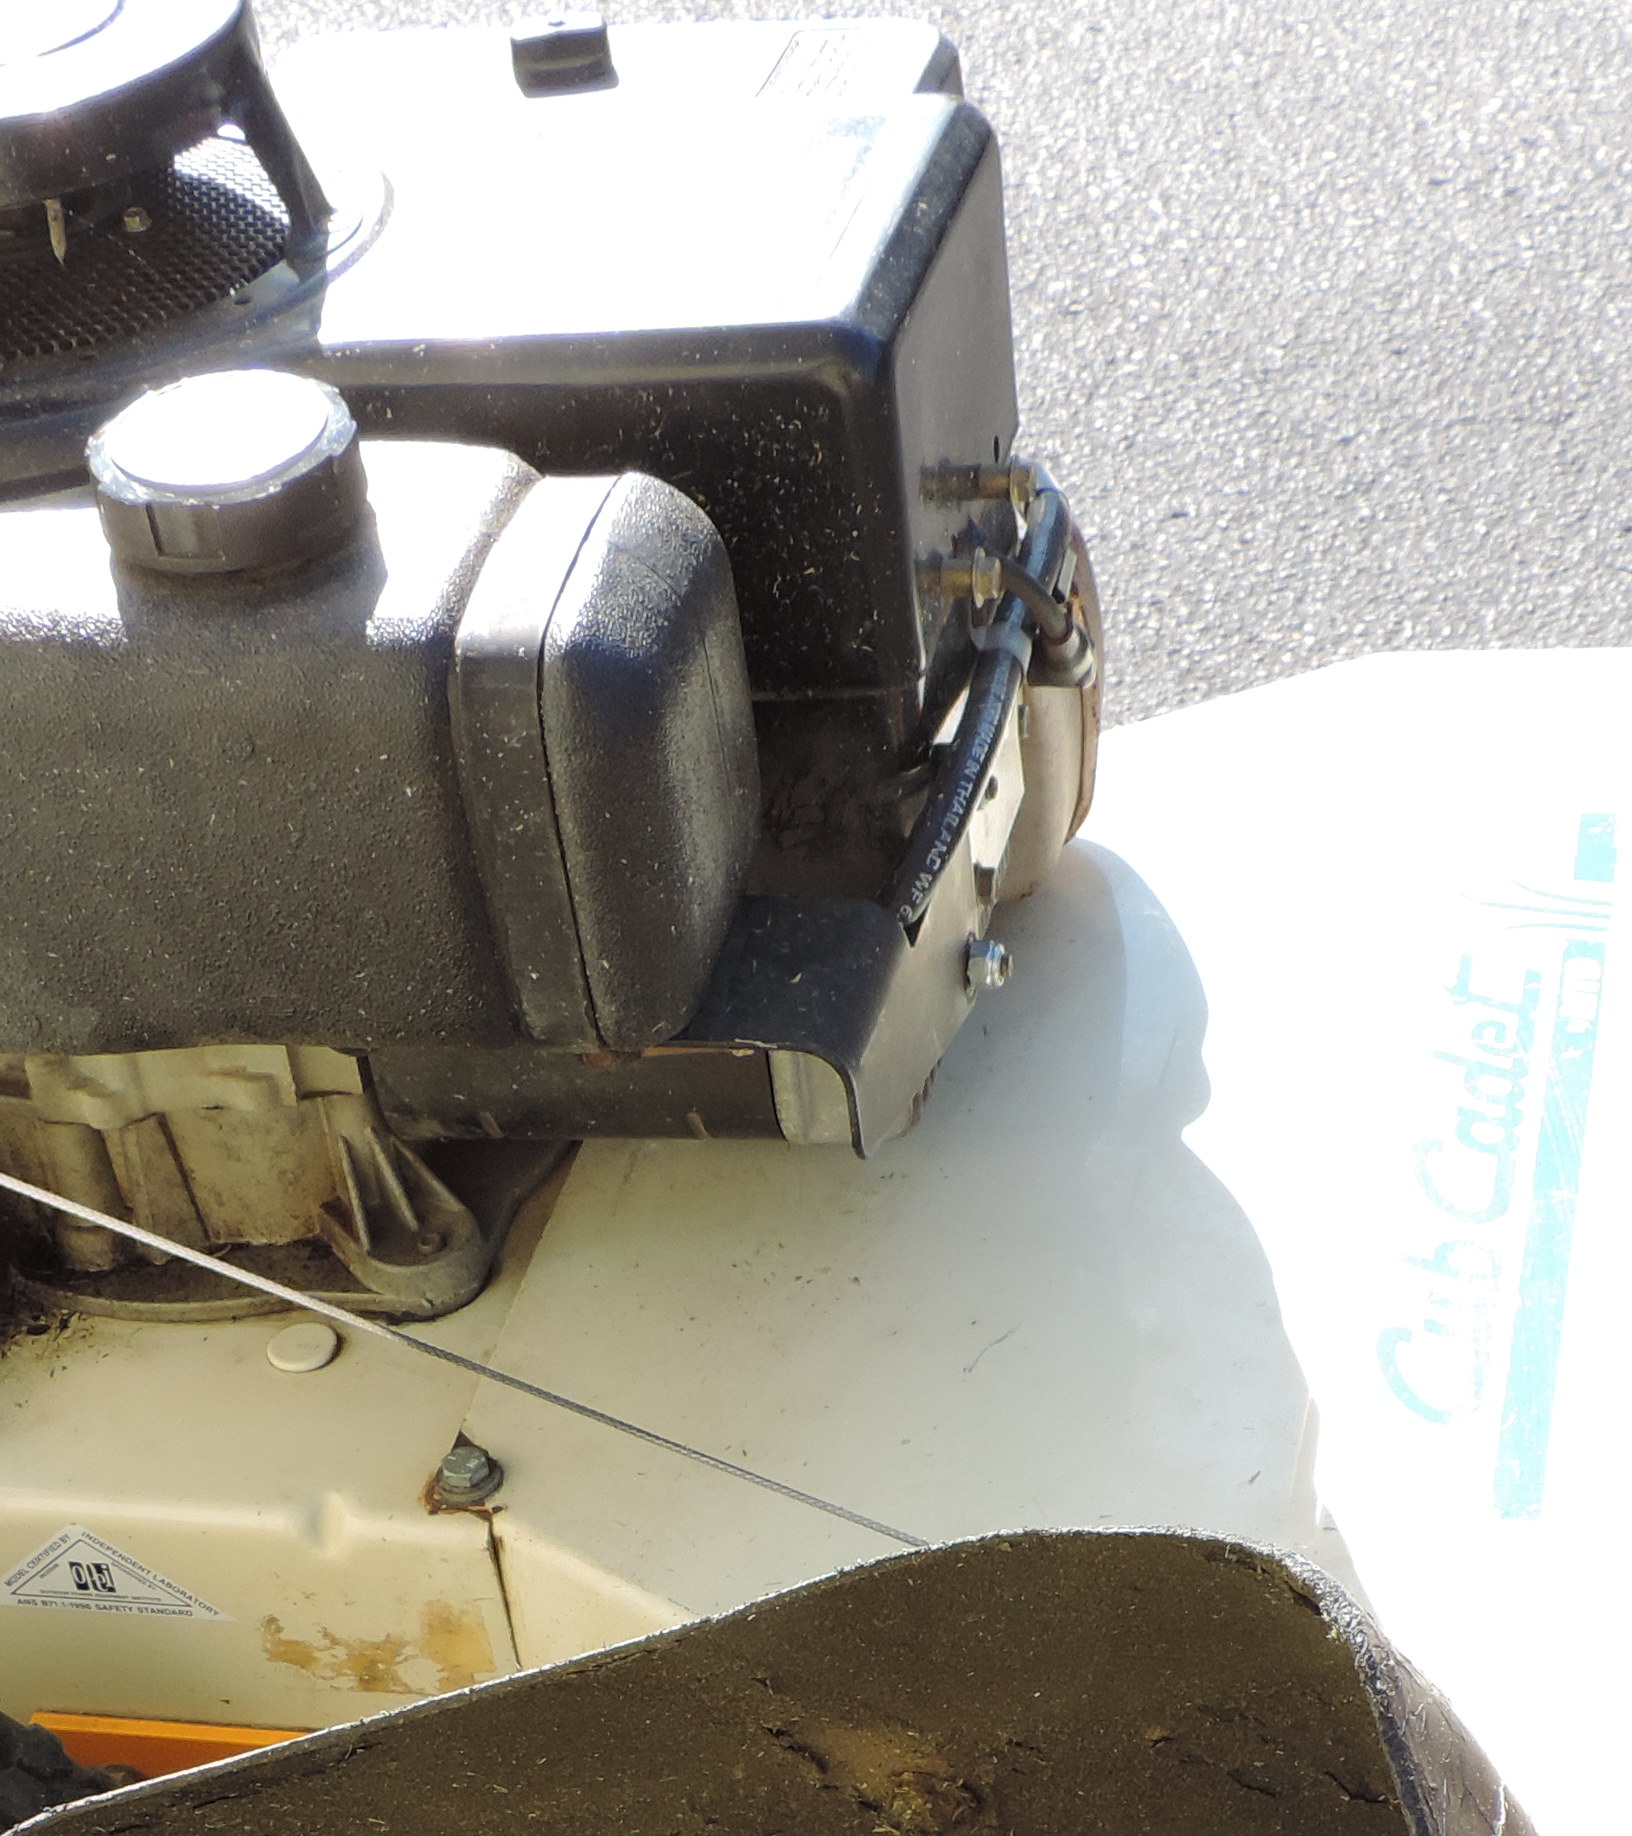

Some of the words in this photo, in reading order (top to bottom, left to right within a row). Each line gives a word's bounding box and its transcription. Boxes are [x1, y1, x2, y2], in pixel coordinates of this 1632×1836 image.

[1412, 952, 1543, 1225] Cadet
[1375, 1238, 1501, 1425] Cub
[4, 1568, 29, 1587] MODEL
[26, 1541, 61, 1569] CERTIFIED
[58, 1533, 71, 1544] BY
[81, 1531, 152, 1576] INDEPENDENT
[152, 1573, 220, 1616] LABORATORY
[95, 1603, 134, 1612] SAFETY
[136, 1606, 194, 1618] STANDARD
